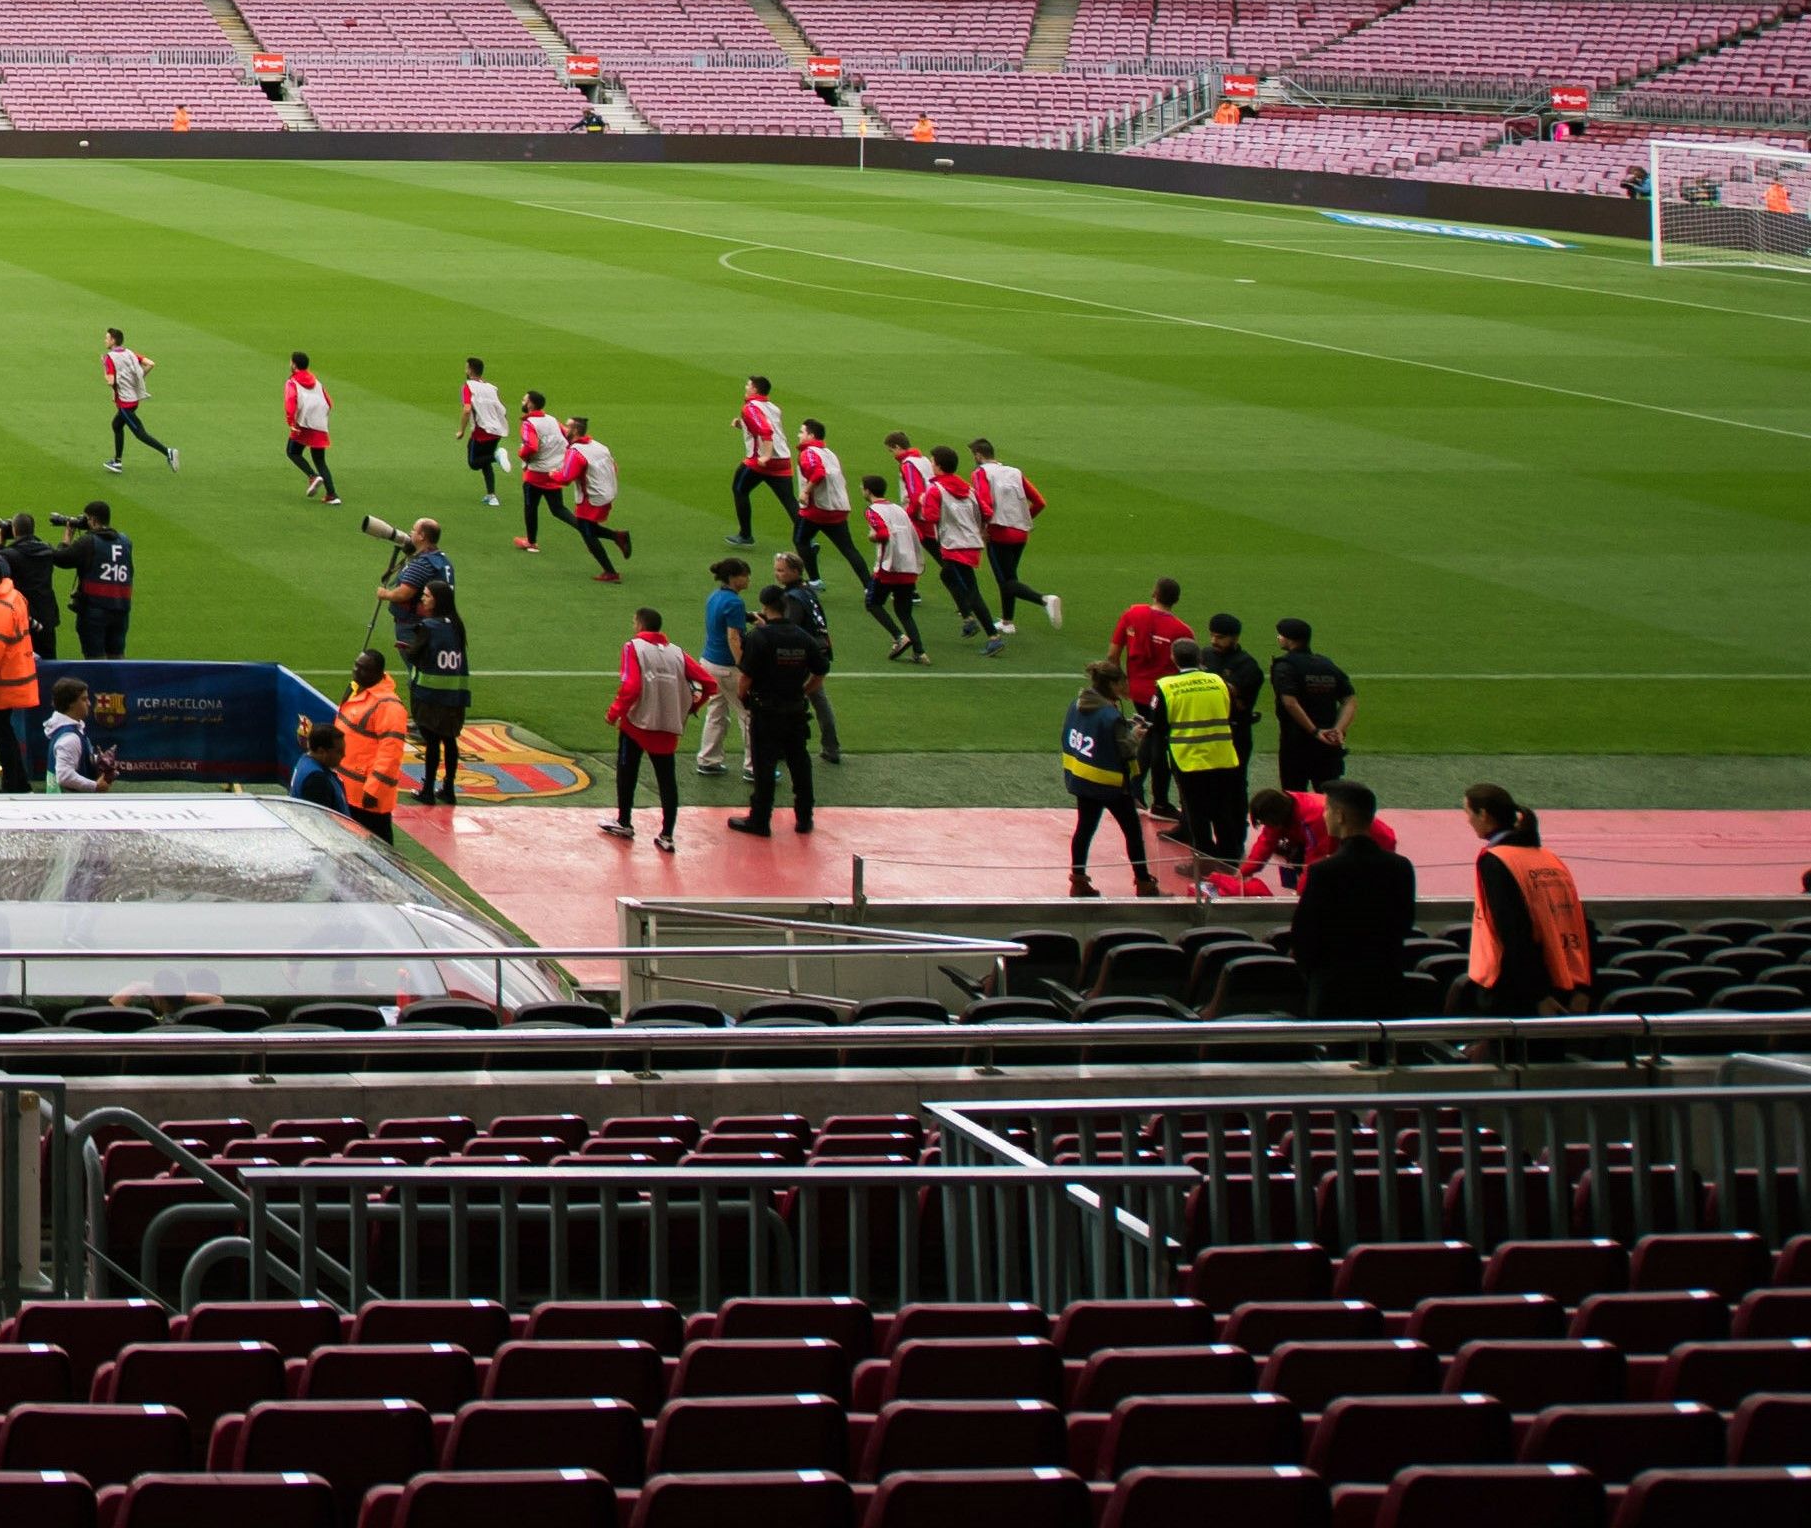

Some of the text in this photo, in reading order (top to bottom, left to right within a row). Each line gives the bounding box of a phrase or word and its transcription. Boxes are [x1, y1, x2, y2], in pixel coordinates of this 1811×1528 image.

[111, 545, 124, 561] F
[99, 562, 128, 583] 216
[436, 650, 463, 670] 001
